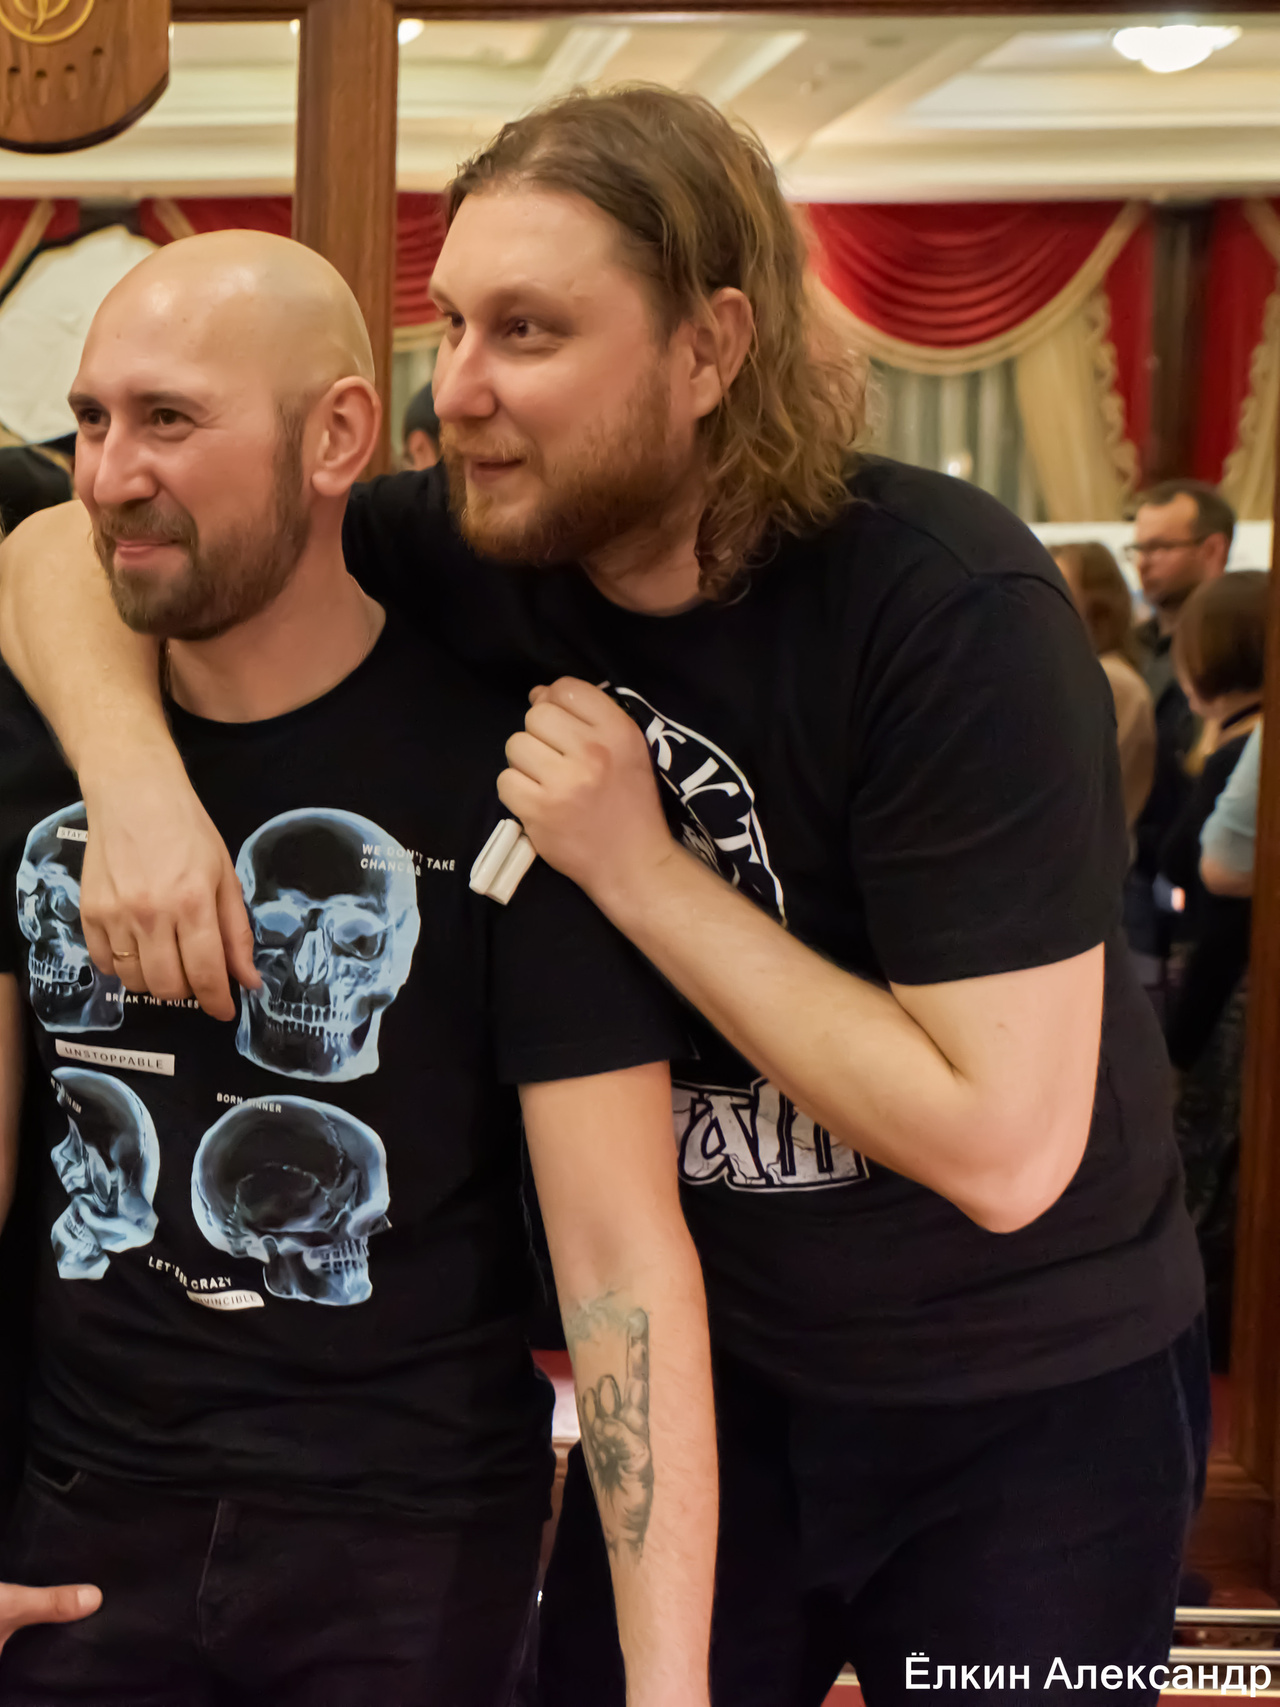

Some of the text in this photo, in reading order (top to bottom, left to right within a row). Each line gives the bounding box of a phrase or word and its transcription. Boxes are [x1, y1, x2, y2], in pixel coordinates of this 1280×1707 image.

[360, 858, 421, 877] CHANCES
[362, 844, 455, 871] WE DON'T TAKE
[105, 992, 138, 1004] BREAK
[143, 995, 162, 1006] THE
[65, 1047, 163, 1069] UNSTOPPABLE
[216, 1092, 243, 1105] BORN
[148, 1255, 180, 1278] LET'S
[191, 1276, 232, 1291] CRAZY
